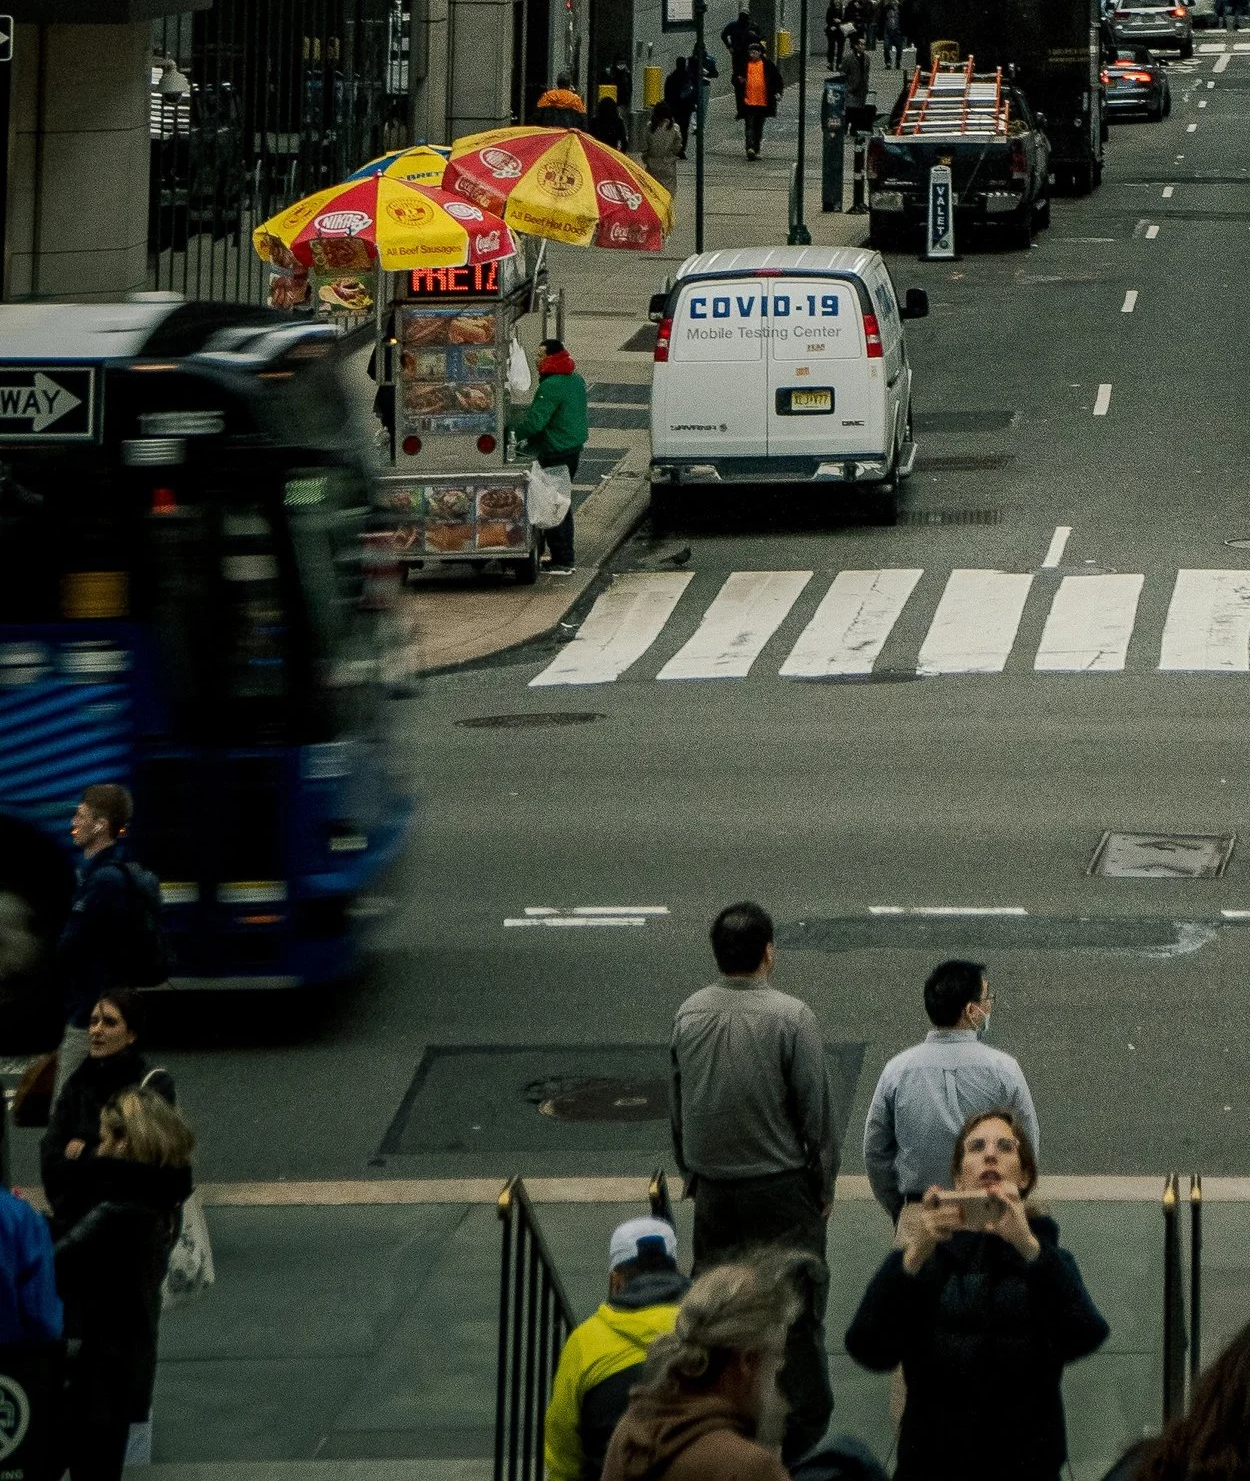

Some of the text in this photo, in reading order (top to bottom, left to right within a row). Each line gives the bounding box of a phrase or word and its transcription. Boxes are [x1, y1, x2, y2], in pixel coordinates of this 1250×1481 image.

[321, 213, 362, 230] NIKAS
[936, 186, 945, 235] VALET
[511, 210, 588, 236] All Beef Hot Dogs
[386, 243, 462, 256] All Beef Sausages
[690, 295, 839, 319] COVID-19
[687, 325, 842, 341] Mobile Testing Center
[0, 389, 62, 414] WAY
